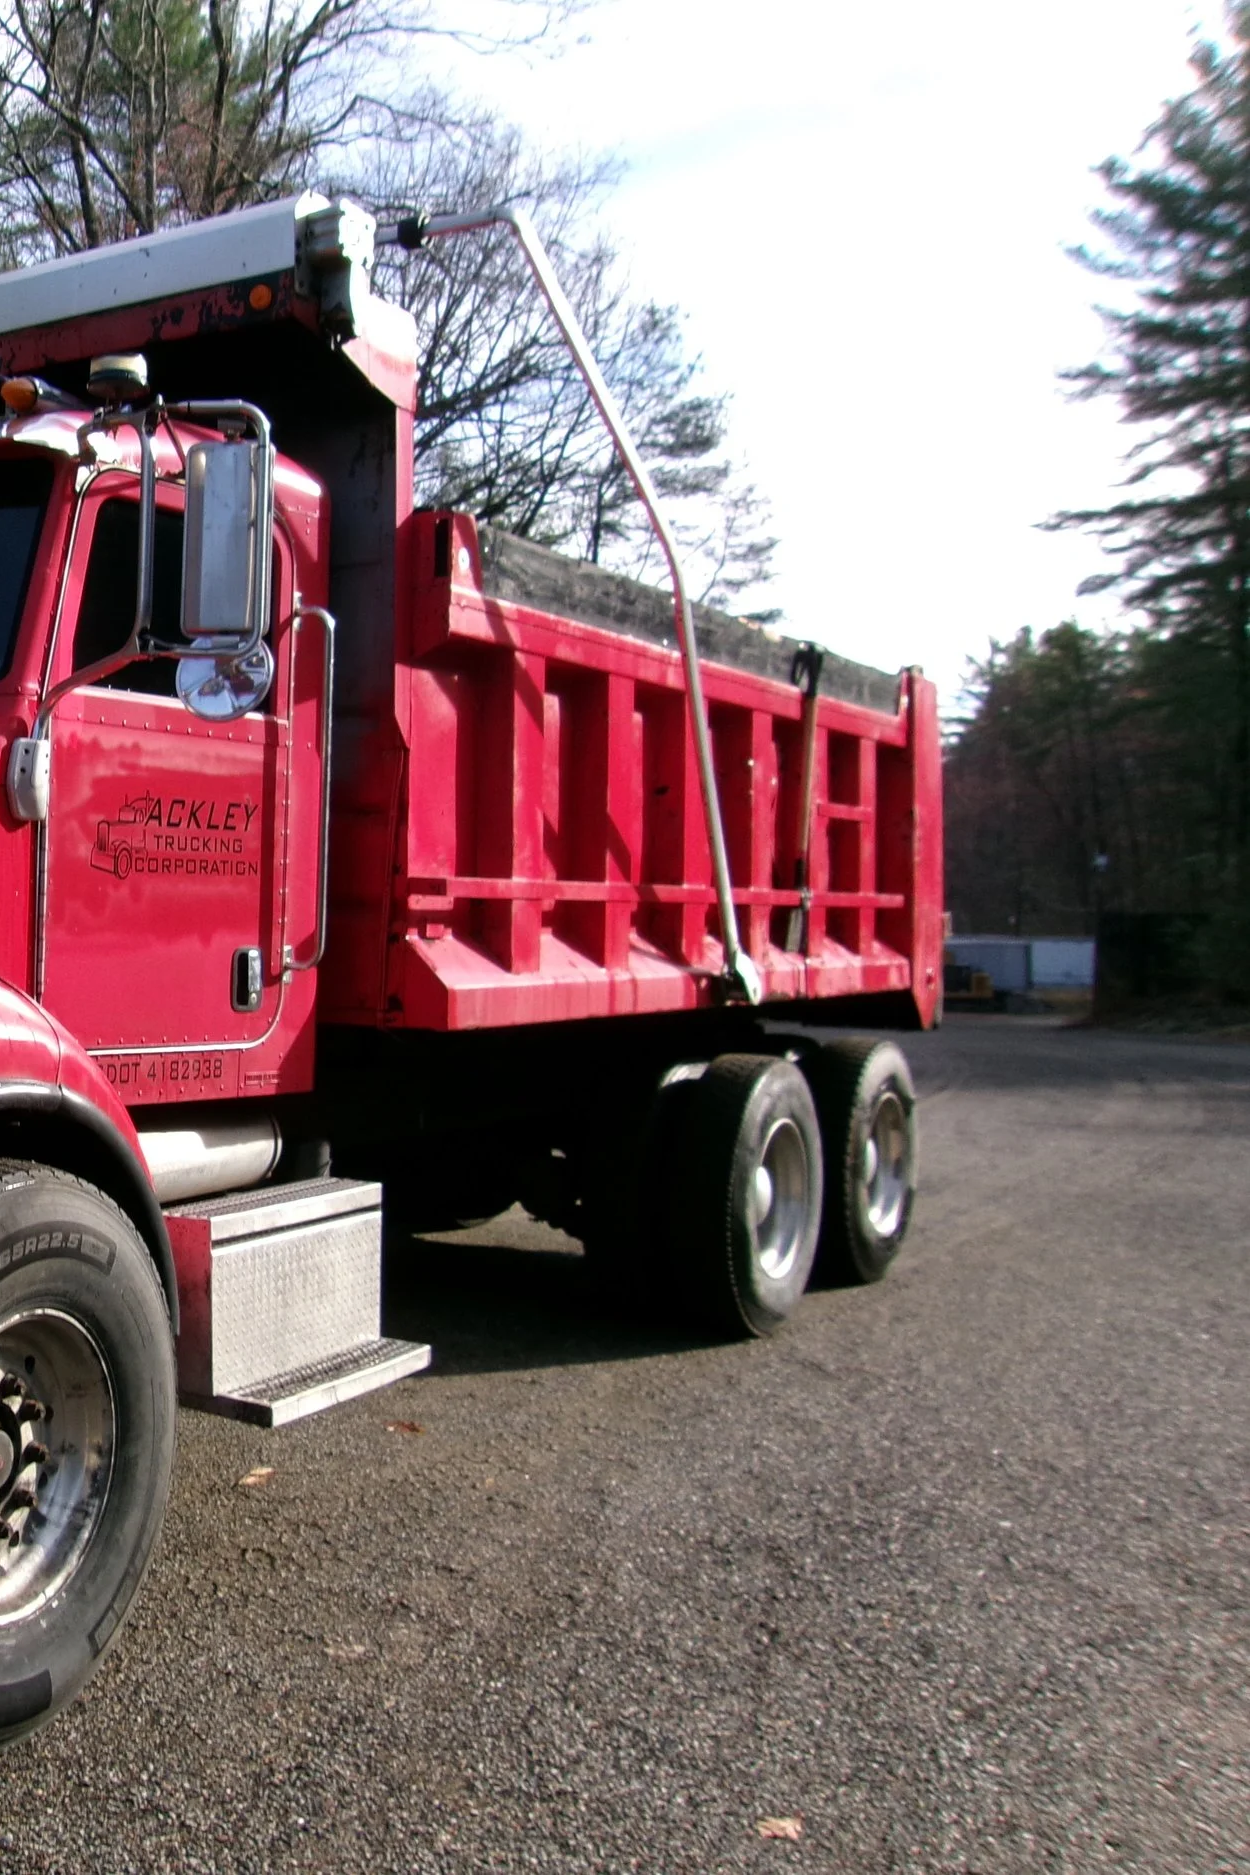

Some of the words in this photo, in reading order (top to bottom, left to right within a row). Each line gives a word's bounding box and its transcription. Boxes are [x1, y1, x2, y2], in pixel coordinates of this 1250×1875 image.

[144, 797, 259, 833] ACKLEY
[153, 834, 244, 854] TRUCKING
[134, 857, 259, 877] CORPORATION
[147, 1058, 223, 1083] 4182938
